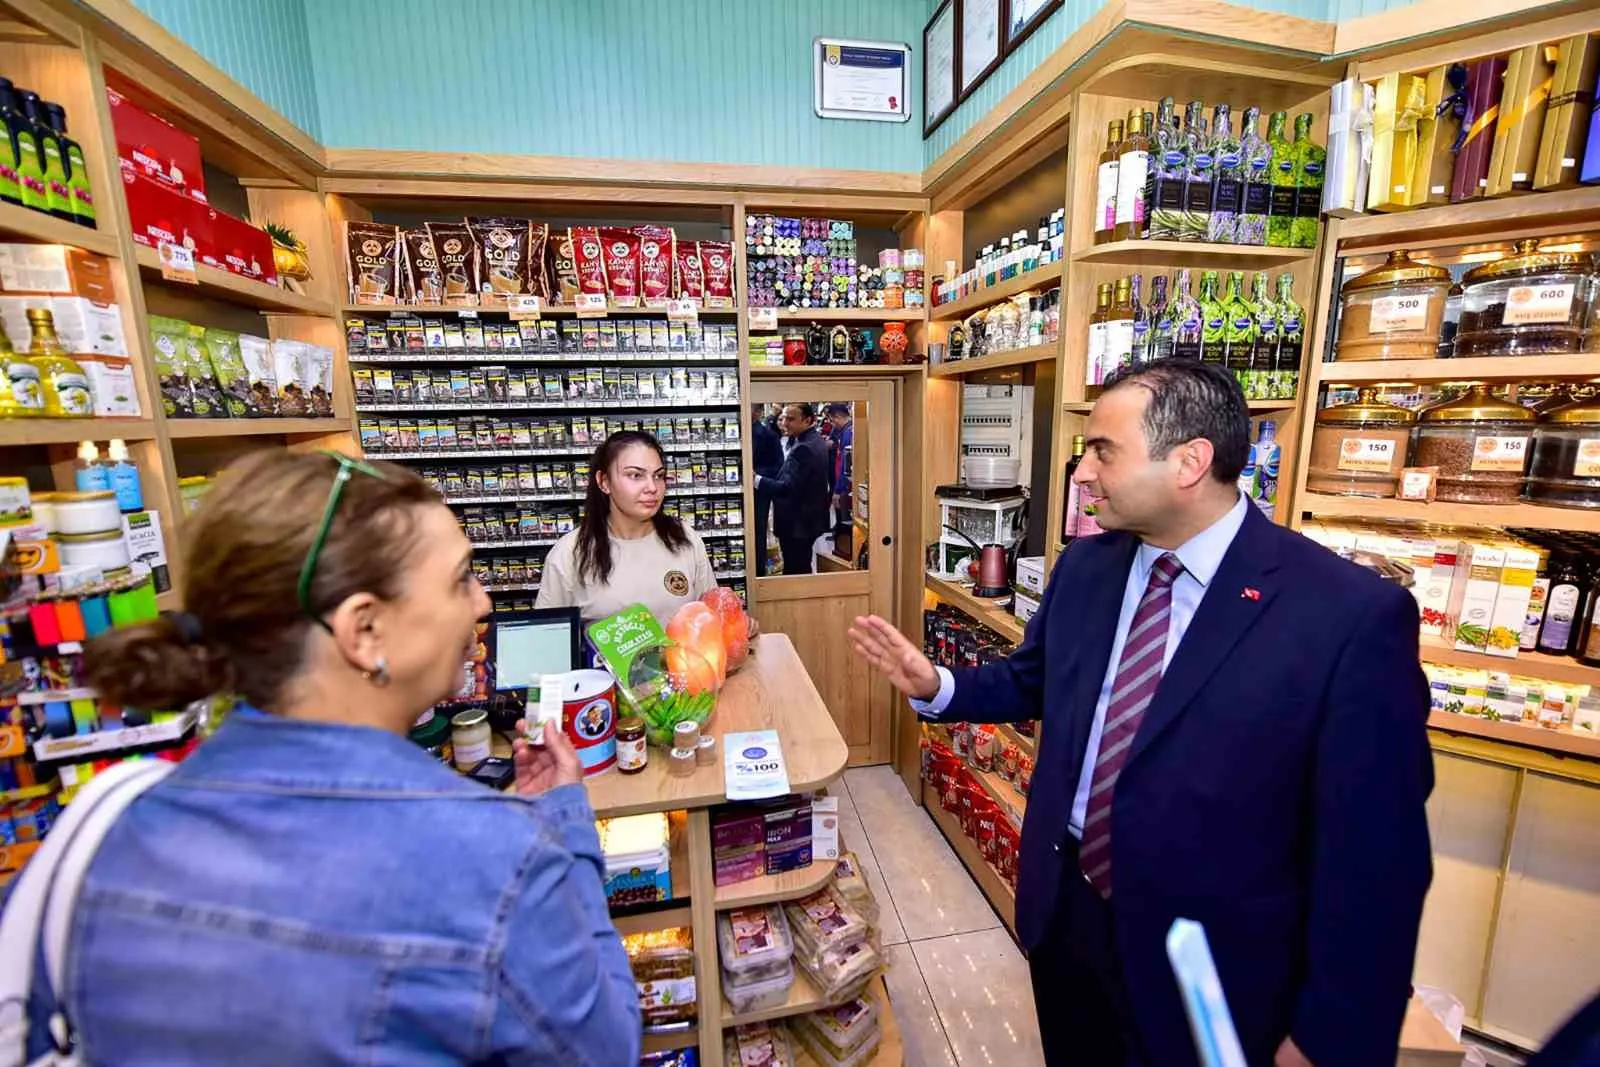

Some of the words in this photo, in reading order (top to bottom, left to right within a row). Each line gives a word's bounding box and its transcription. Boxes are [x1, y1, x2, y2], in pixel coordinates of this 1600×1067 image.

[485, 248, 520, 261] GOLD
[356, 255, 387, 265] GOLD
[555, 260, 573, 269] GO
[1540, 290, 1564, 299] 600
[1398, 300, 1419, 309] 500
[1504, 442, 1521, 450] 150
[767, 825, 791, 837] IRON
